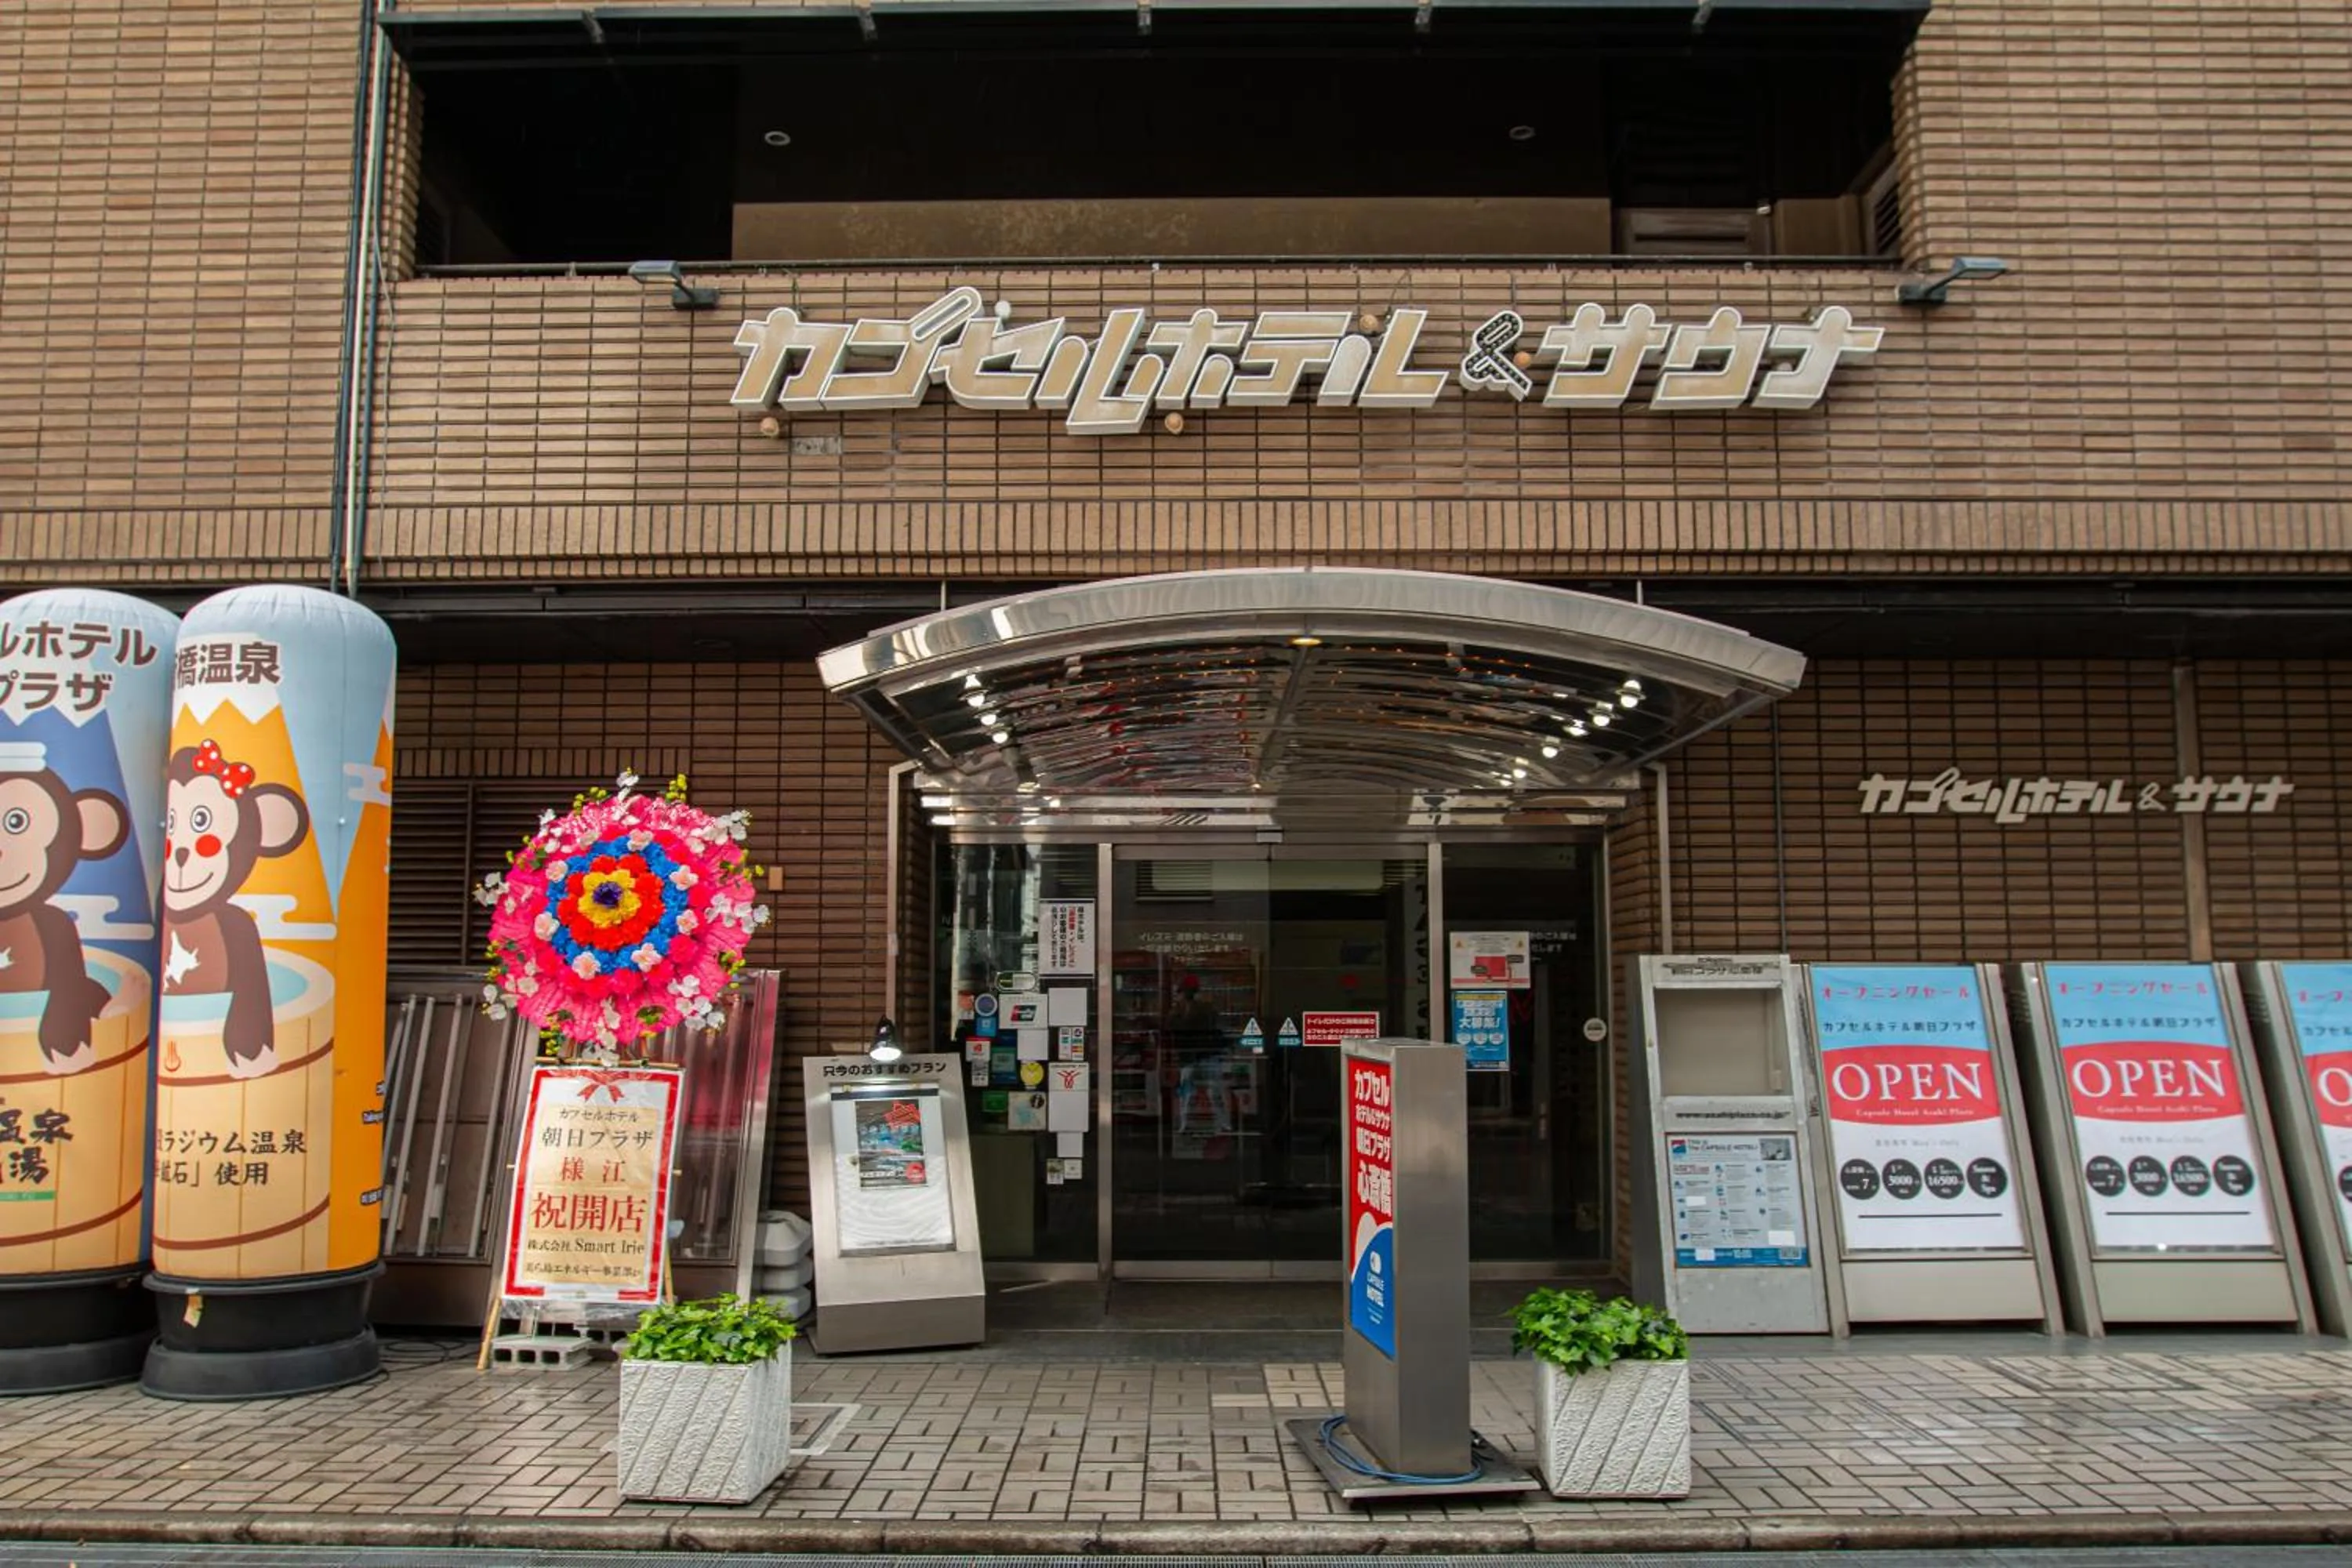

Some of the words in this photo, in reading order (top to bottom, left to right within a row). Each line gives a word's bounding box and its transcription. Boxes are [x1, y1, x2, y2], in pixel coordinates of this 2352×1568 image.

[174, 641, 281, 689] 橋温泉
[1355, 1069, 1391, 1108] カプセル
[1831, 1062, 1984, 1102] OPEN
[2071, 1058, 2227, 1099] OPEN
[157, 1128, 307, 1156] ラジウム温泉
[542, 1126, 654, 1150] 朝日プラザ
[530, 1192, 648, 1235] 祝開店
[574, 1237, 615, 1254] Smart
[620, 1240, 646, 1254] Irie
